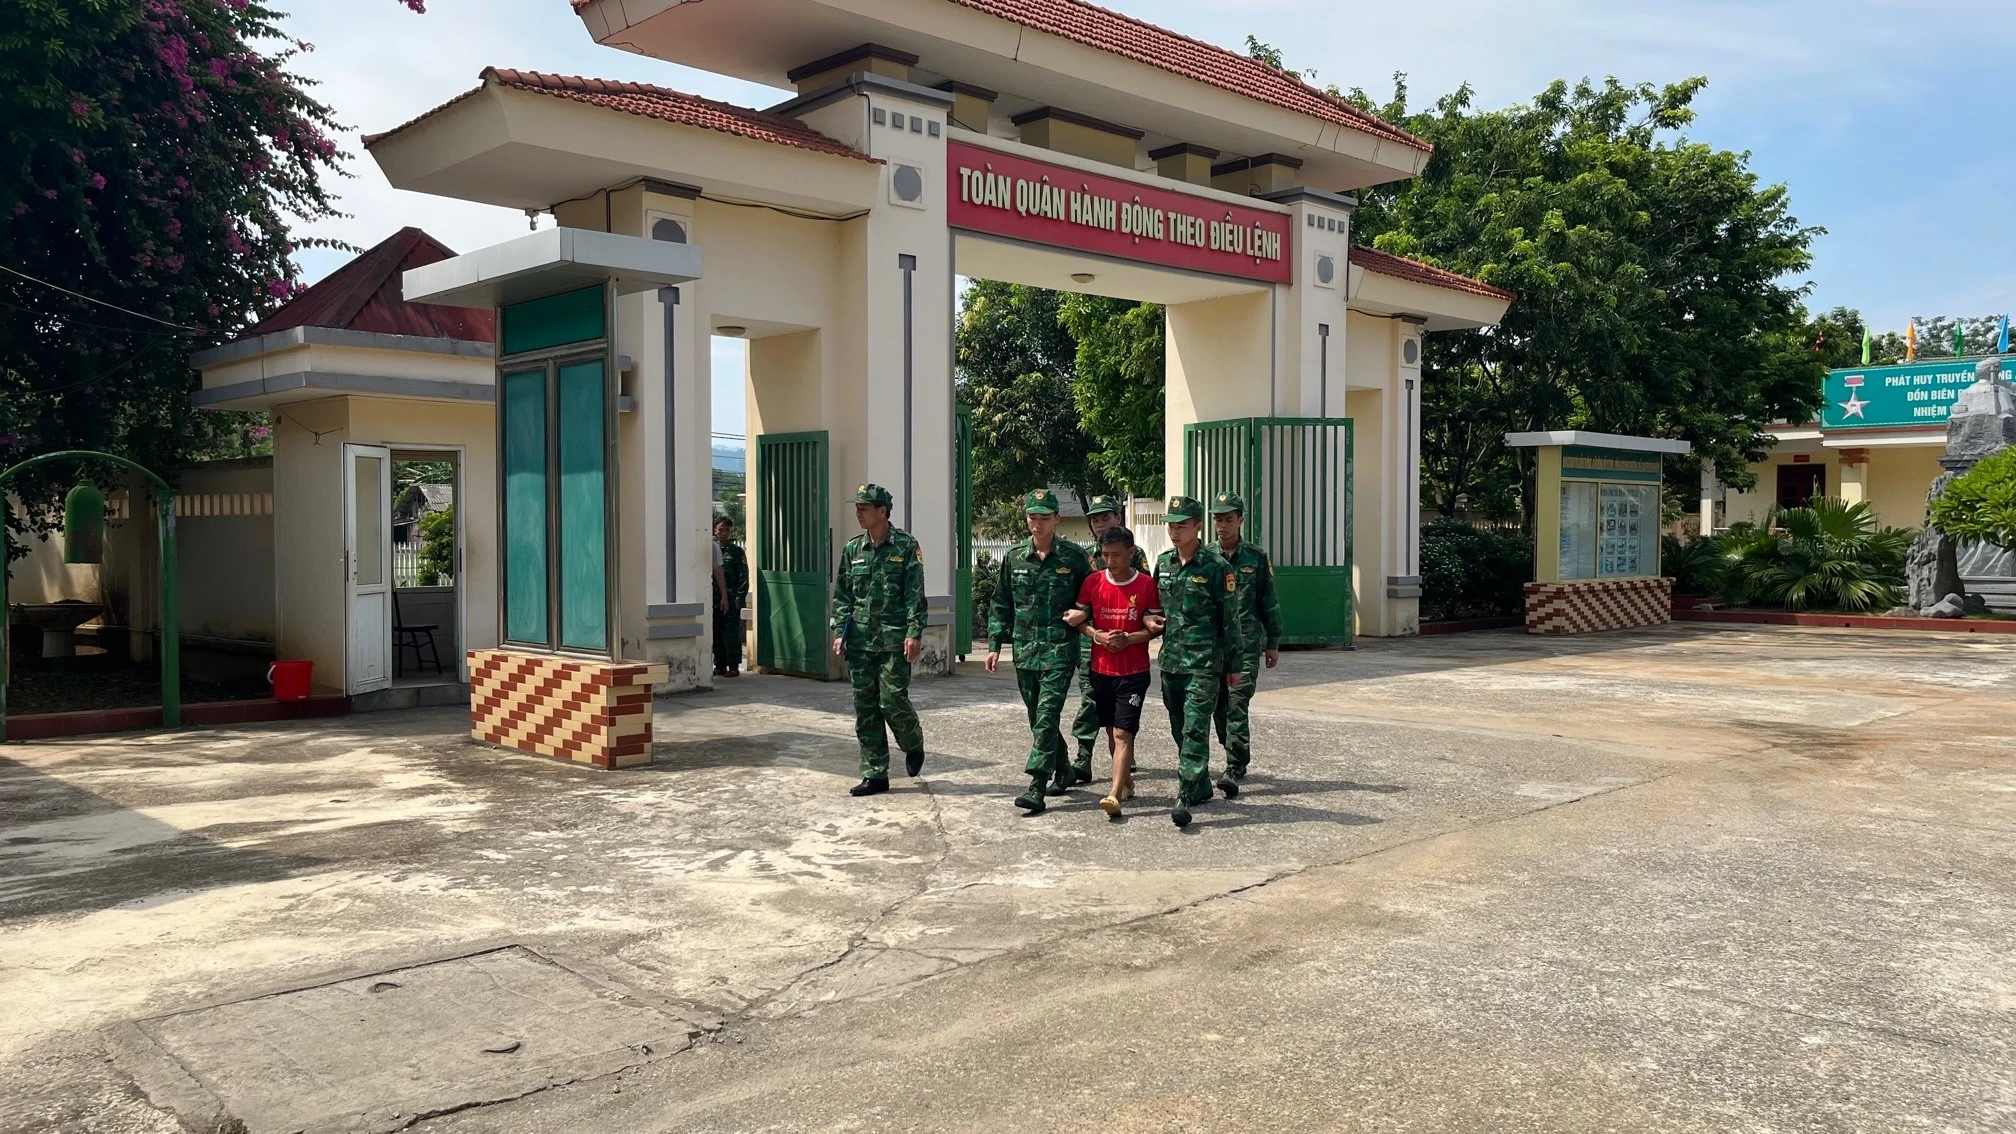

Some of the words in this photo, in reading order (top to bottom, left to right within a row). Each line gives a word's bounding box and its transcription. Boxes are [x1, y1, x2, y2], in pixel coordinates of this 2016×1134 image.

[960, 163, 1011, 210] TOÀN
[1016, 175, 1065, 220] QUÂN
[1070, 184, 1116, 231] HÀNH
[1121, 196, 1163, 243] ĐỘNG
[1167, 211, 1205, 248] THEO
[1209, 211, 1243, 254] ĐIỀU
[1246, 221, 1280, 264] LỆNH
[1885, 374, 1911, 387] PHÁT
[1913, 374, 1933, 385] HUY
[1931, 387, 1955, 400] BIÊN
[1913, 404, 1947, 418] NHIỆM
